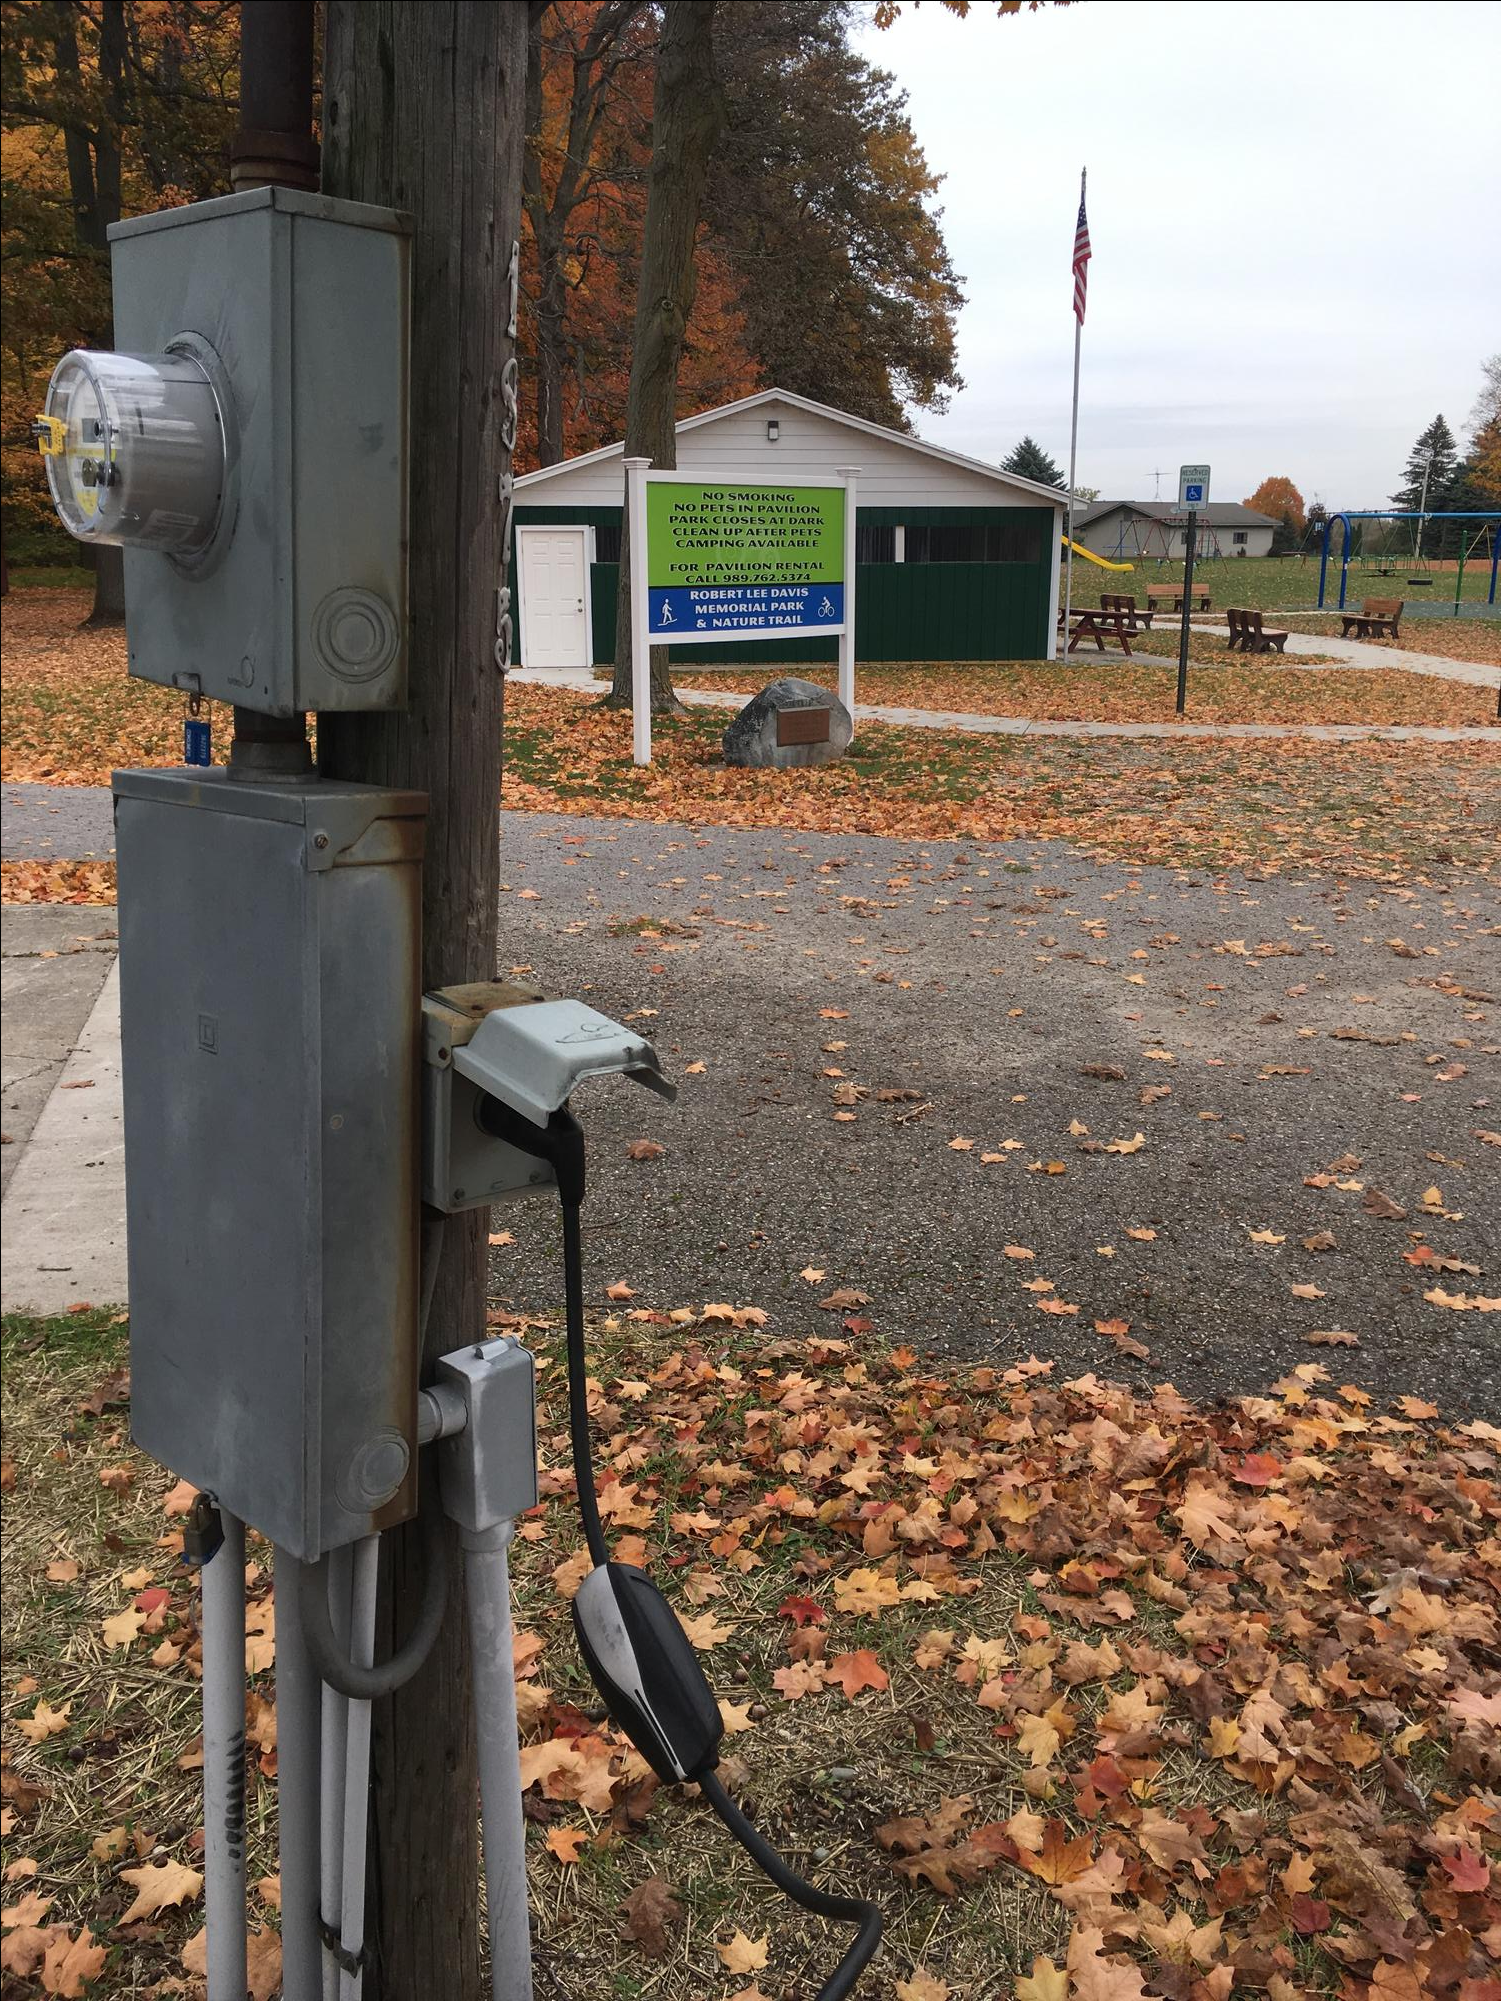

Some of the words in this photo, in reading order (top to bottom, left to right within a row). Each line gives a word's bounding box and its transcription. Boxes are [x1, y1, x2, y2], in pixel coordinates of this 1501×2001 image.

[702, 492, 724, 500] NO
[728, 493, 795, 502] SMOKING
[674, 503, 696, 512] NO
[700, 504, 735, 512] PETS
[738, 505, 753, 513] IN
[757, 505, 820, 514] PAVILION
[669, 515, 709, 524] PARK
[712, 516, 766, 525] CLOSES
[769, 517, 785, 525] AT
[789, 517, 825, 525] DARK
[672, 527, 719, 536] CLEAN
[723, 528, 743, 536] UP
[746, 528, 787, 536] AFTER
[790, 528, 822, 536] PETS
[675, 539, 745, 548] CAMPING
[747, 539, 819, 548] AVAILABLE
[669, 563, 699, 572] FOR
[706, 562, 772, 571] PAVILION
[776, 562, 825, 570] RENTAL
[685, 575, 720, 584] CALL
[723, 573, 811, 583] 989.762.5374
[690, 589, 743, 600] ROBERT
[746, 588, 768, 599] LEE
[771, 587, 809, 598] DAVIS
[695, 602, 768, 614] MEMORIAL
[771, 601, 805, 611] PARK
[696, 619, 707, 628] &
[712, 616, 766, 628] NATURE
[768, 615, 803, 625] TRAIL
